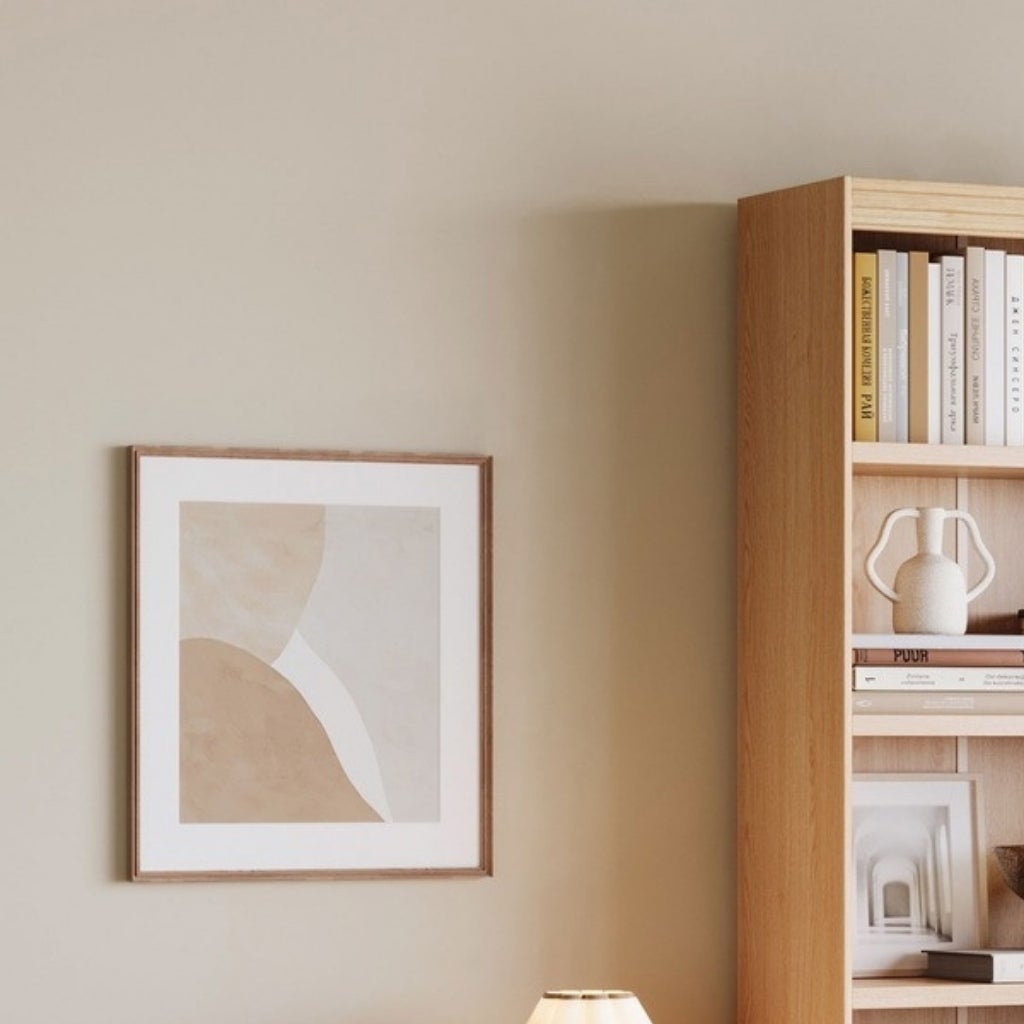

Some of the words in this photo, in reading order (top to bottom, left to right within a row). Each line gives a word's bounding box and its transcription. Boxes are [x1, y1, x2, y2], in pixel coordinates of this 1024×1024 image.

[1011, 296, 1020, 336] ДЖЕН
[1011, 347, 1020, 414] СИНСЕРО
[861, 393, 874, 419] РАЙ
[893, 649, 930, 663] PUUR
